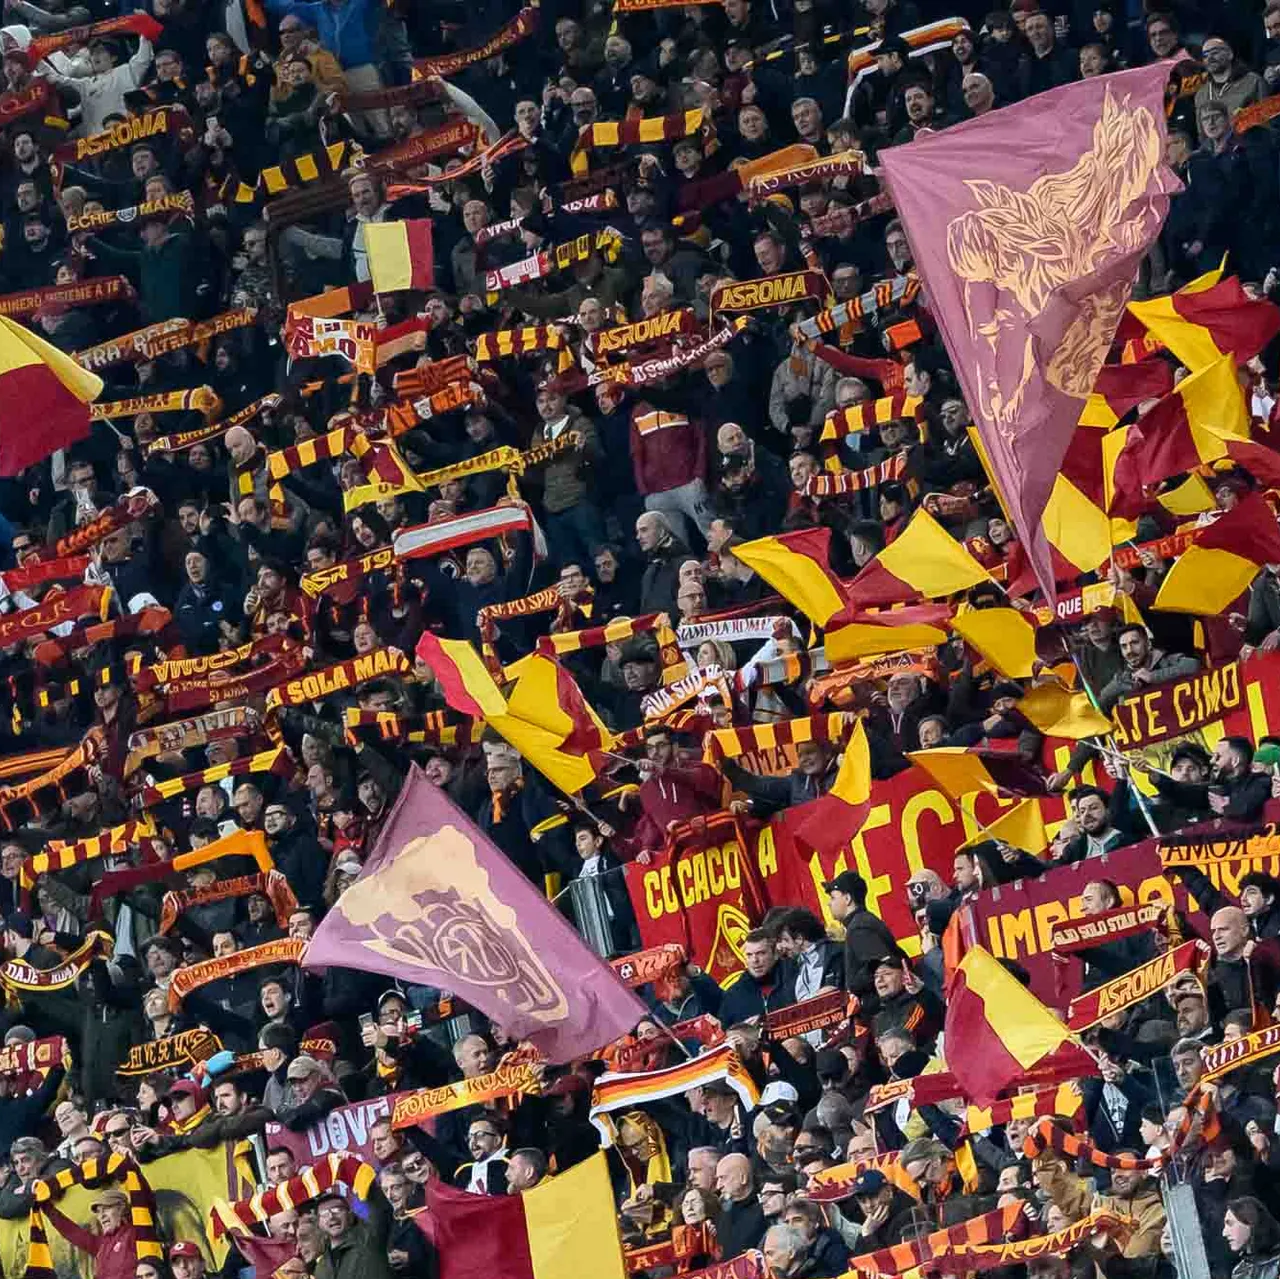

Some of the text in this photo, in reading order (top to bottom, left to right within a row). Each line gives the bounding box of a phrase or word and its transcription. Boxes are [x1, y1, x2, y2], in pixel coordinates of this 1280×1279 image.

[76, 109, 168, 160] ASROMA
[720, 275, 807, 311] ASROMA
[598, 312, 682, 355] ASROMA
[302, 559, 348, 596] ASR
[287, 663, 350, 702] SOLA
[672, 672, 702, 705] SUD
[1169, 663, 1242, 732] CIMO
[6, 961, 38, 987] DAJE
[1097, 954, 1177, 1020] ASROMA
[398, 1083, 457, 1121] FORZA
[1002, 1216, 1091, 1262] ROMA
